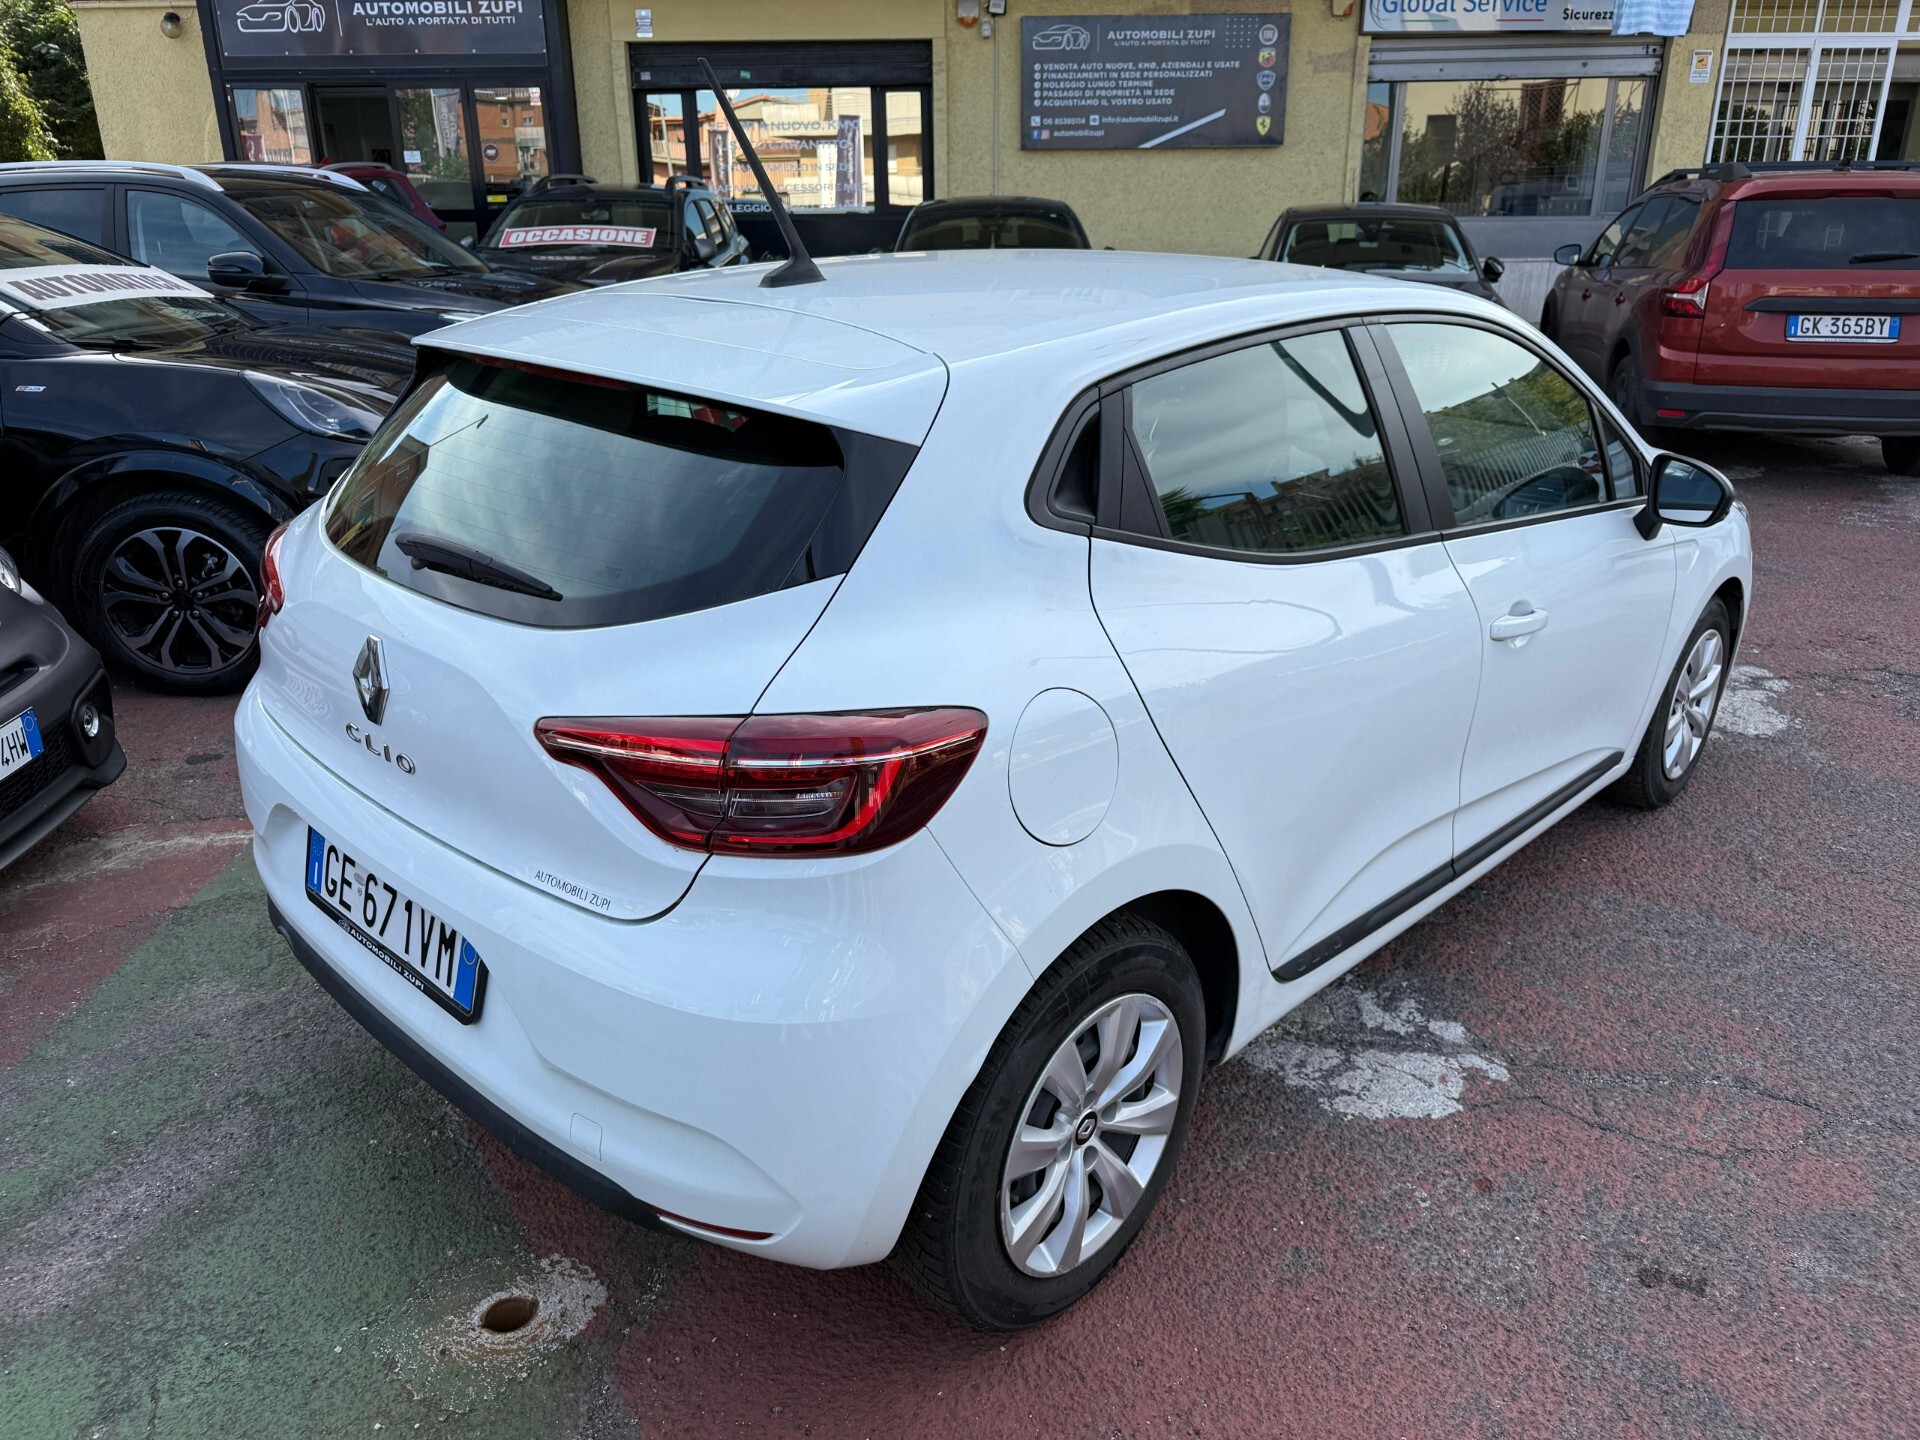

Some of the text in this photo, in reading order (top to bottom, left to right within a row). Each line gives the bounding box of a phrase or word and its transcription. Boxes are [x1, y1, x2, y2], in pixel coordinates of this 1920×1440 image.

[352, 0, 524, 16] AUTOMOBILI ZUPI
[1382, 0, 1548, 14] Global Service
[365, 16, 516, 27] L'AUTO A PORTATA DI TUTTI
[1106, 29, 1216, 40] AUTOMOBILI ZUPI
[1105, 62, 1136, 70] NUOVE,
[1161, 61, 1205, 69] AZIENDALI
[1214, 61, 1241, 69] USATE
[1042, 71, 1107, 79] FINANZIAMENTI
[1120, 70, 1141, 78] SEDE
[1143, 70, 1212, 78] PERSONALIZZATI
[1042, 80, 1153, 89] NOLEGGIO LUNGO TERMINE
[1042, 89, 1082, 97] PASSAGGI
[1084, 89, 1094, 97] DI
[1096, 88, 1141, 96] PROPRIETÀ
[1154, 88, 1175, 96] SEDE
[1042, 98, 1099, 106] ACQUISTIAMO
[1110, 97, 1143, 105] VOSTRO
[1145, 97, 1173, 105] USATO
[508, 228, 648, 244] OCCASIONE
[7, 273, 192, 301] AUTOMATICA
[1800, 317, 1823, 335] GK
[1829, 317, 1888, 335] 365BY
[345, 722, 416, 775] CLIO
[534, 869, 611, 911] AUTOMOBILI ZUPI
[324, 844, 356, 913] GE
[362, 872, 458, 988] 671VM
[350, 929, 425, 991] AUTOMOBILI ZUPI
